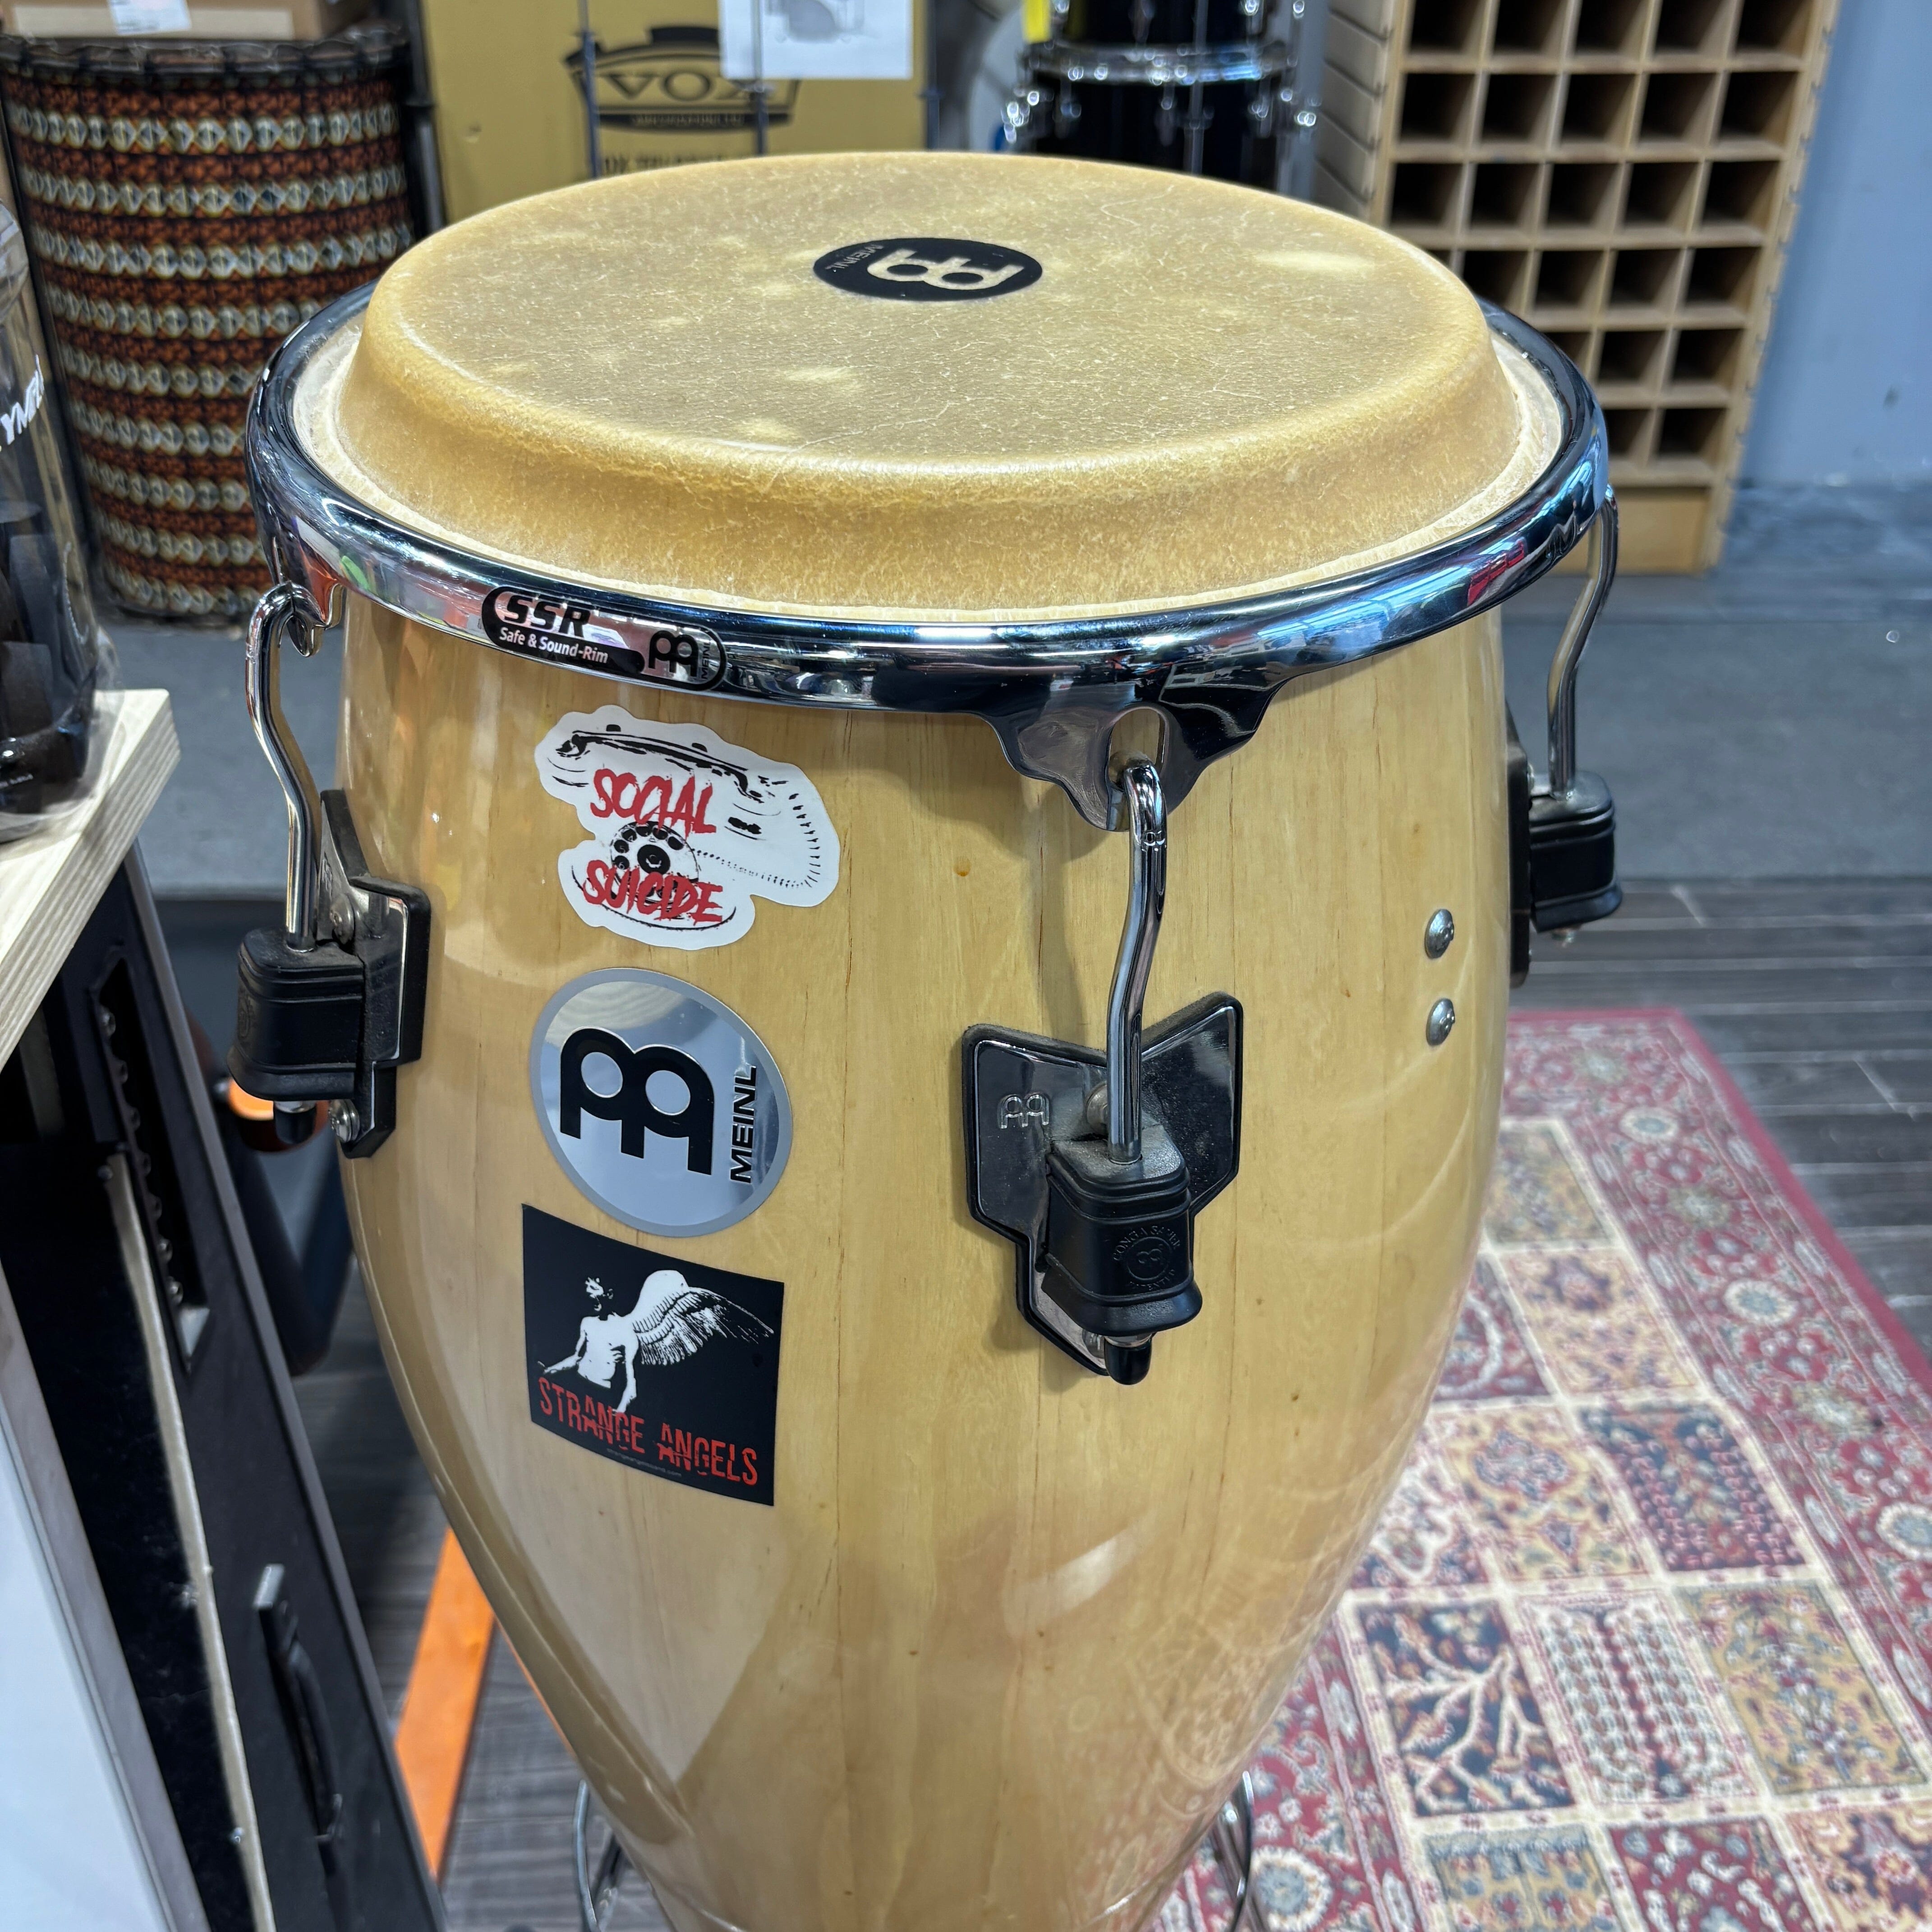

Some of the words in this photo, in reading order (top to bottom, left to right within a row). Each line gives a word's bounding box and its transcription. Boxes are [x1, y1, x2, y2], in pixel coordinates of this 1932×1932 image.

[824, 244, 883, 270] MEINL
[504, 594, 591, 637] SSR
[499, 627, 524, 646] Safe
[528, 633, 537, 649] &
[538, 636, 608, 664] Sound-Rim
[701, 641, 711, 679] MEINL
[590, 768, 717, 840] SOCIAL
[583, 860, 723, 926] SUICIDE
[729, 1066, 757, 1184] MEINL
[538, 1377, 645, 1454] STRANGE
[654, 1422, 758, 1486] ANGELS
